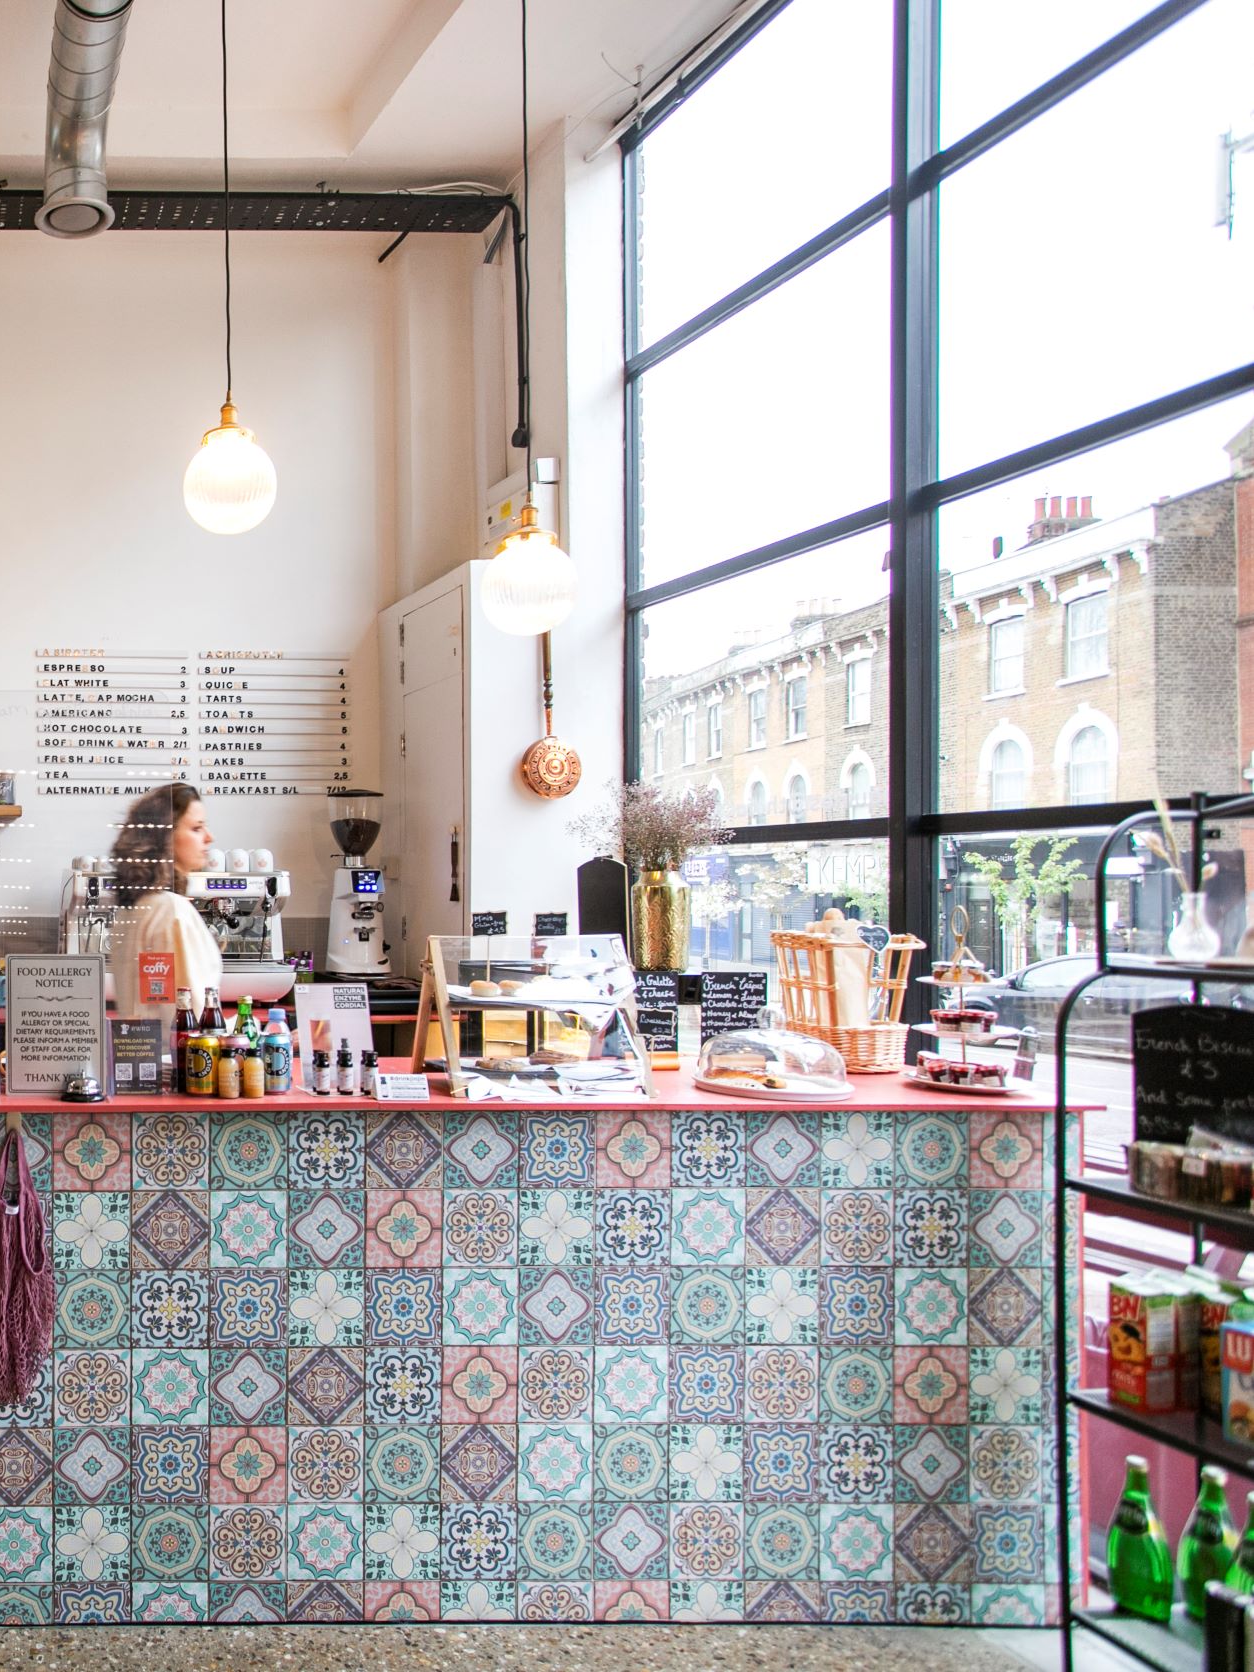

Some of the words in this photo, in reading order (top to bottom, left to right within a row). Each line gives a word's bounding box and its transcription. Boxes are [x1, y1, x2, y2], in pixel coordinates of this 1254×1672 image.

[180, 666, 186, 674] 2
[338, 668, 344, 676] 4
[74, 679, 109, 687] WHITE
[116, 694, 154, 702] MOCHA
[180, 695, 186, 703] 3
[206, 695, 242, 703] TARTS
[71, 725, 142, 734] CHOCOLATE
[342, 726, 347, 734] 5
[78, 740, 114, 748] DRINK
[44, 756, 84, 764] FRESH
[341, 758, 347, 766] 3
[46, 771, 69, 779] TEA
[208, 772, 267, 780] BAGUETTE
[124, 786, 150, 794] MILK
[17, 968, 46, 976] FOOD
[48, 968, 92, 976] ALLERGY
[143, 962, 170, 974] coffy
[35, 980, 74, 988] NOTICE
[1136, 1029, 1189, 1051] French
[24, 1074, 60, 1082] THANK
[1136, 1085, 1167, 1104] And
[1111, 1295, 1142, 1321] BN
[1226, 1332, 1253, 1362] LU
